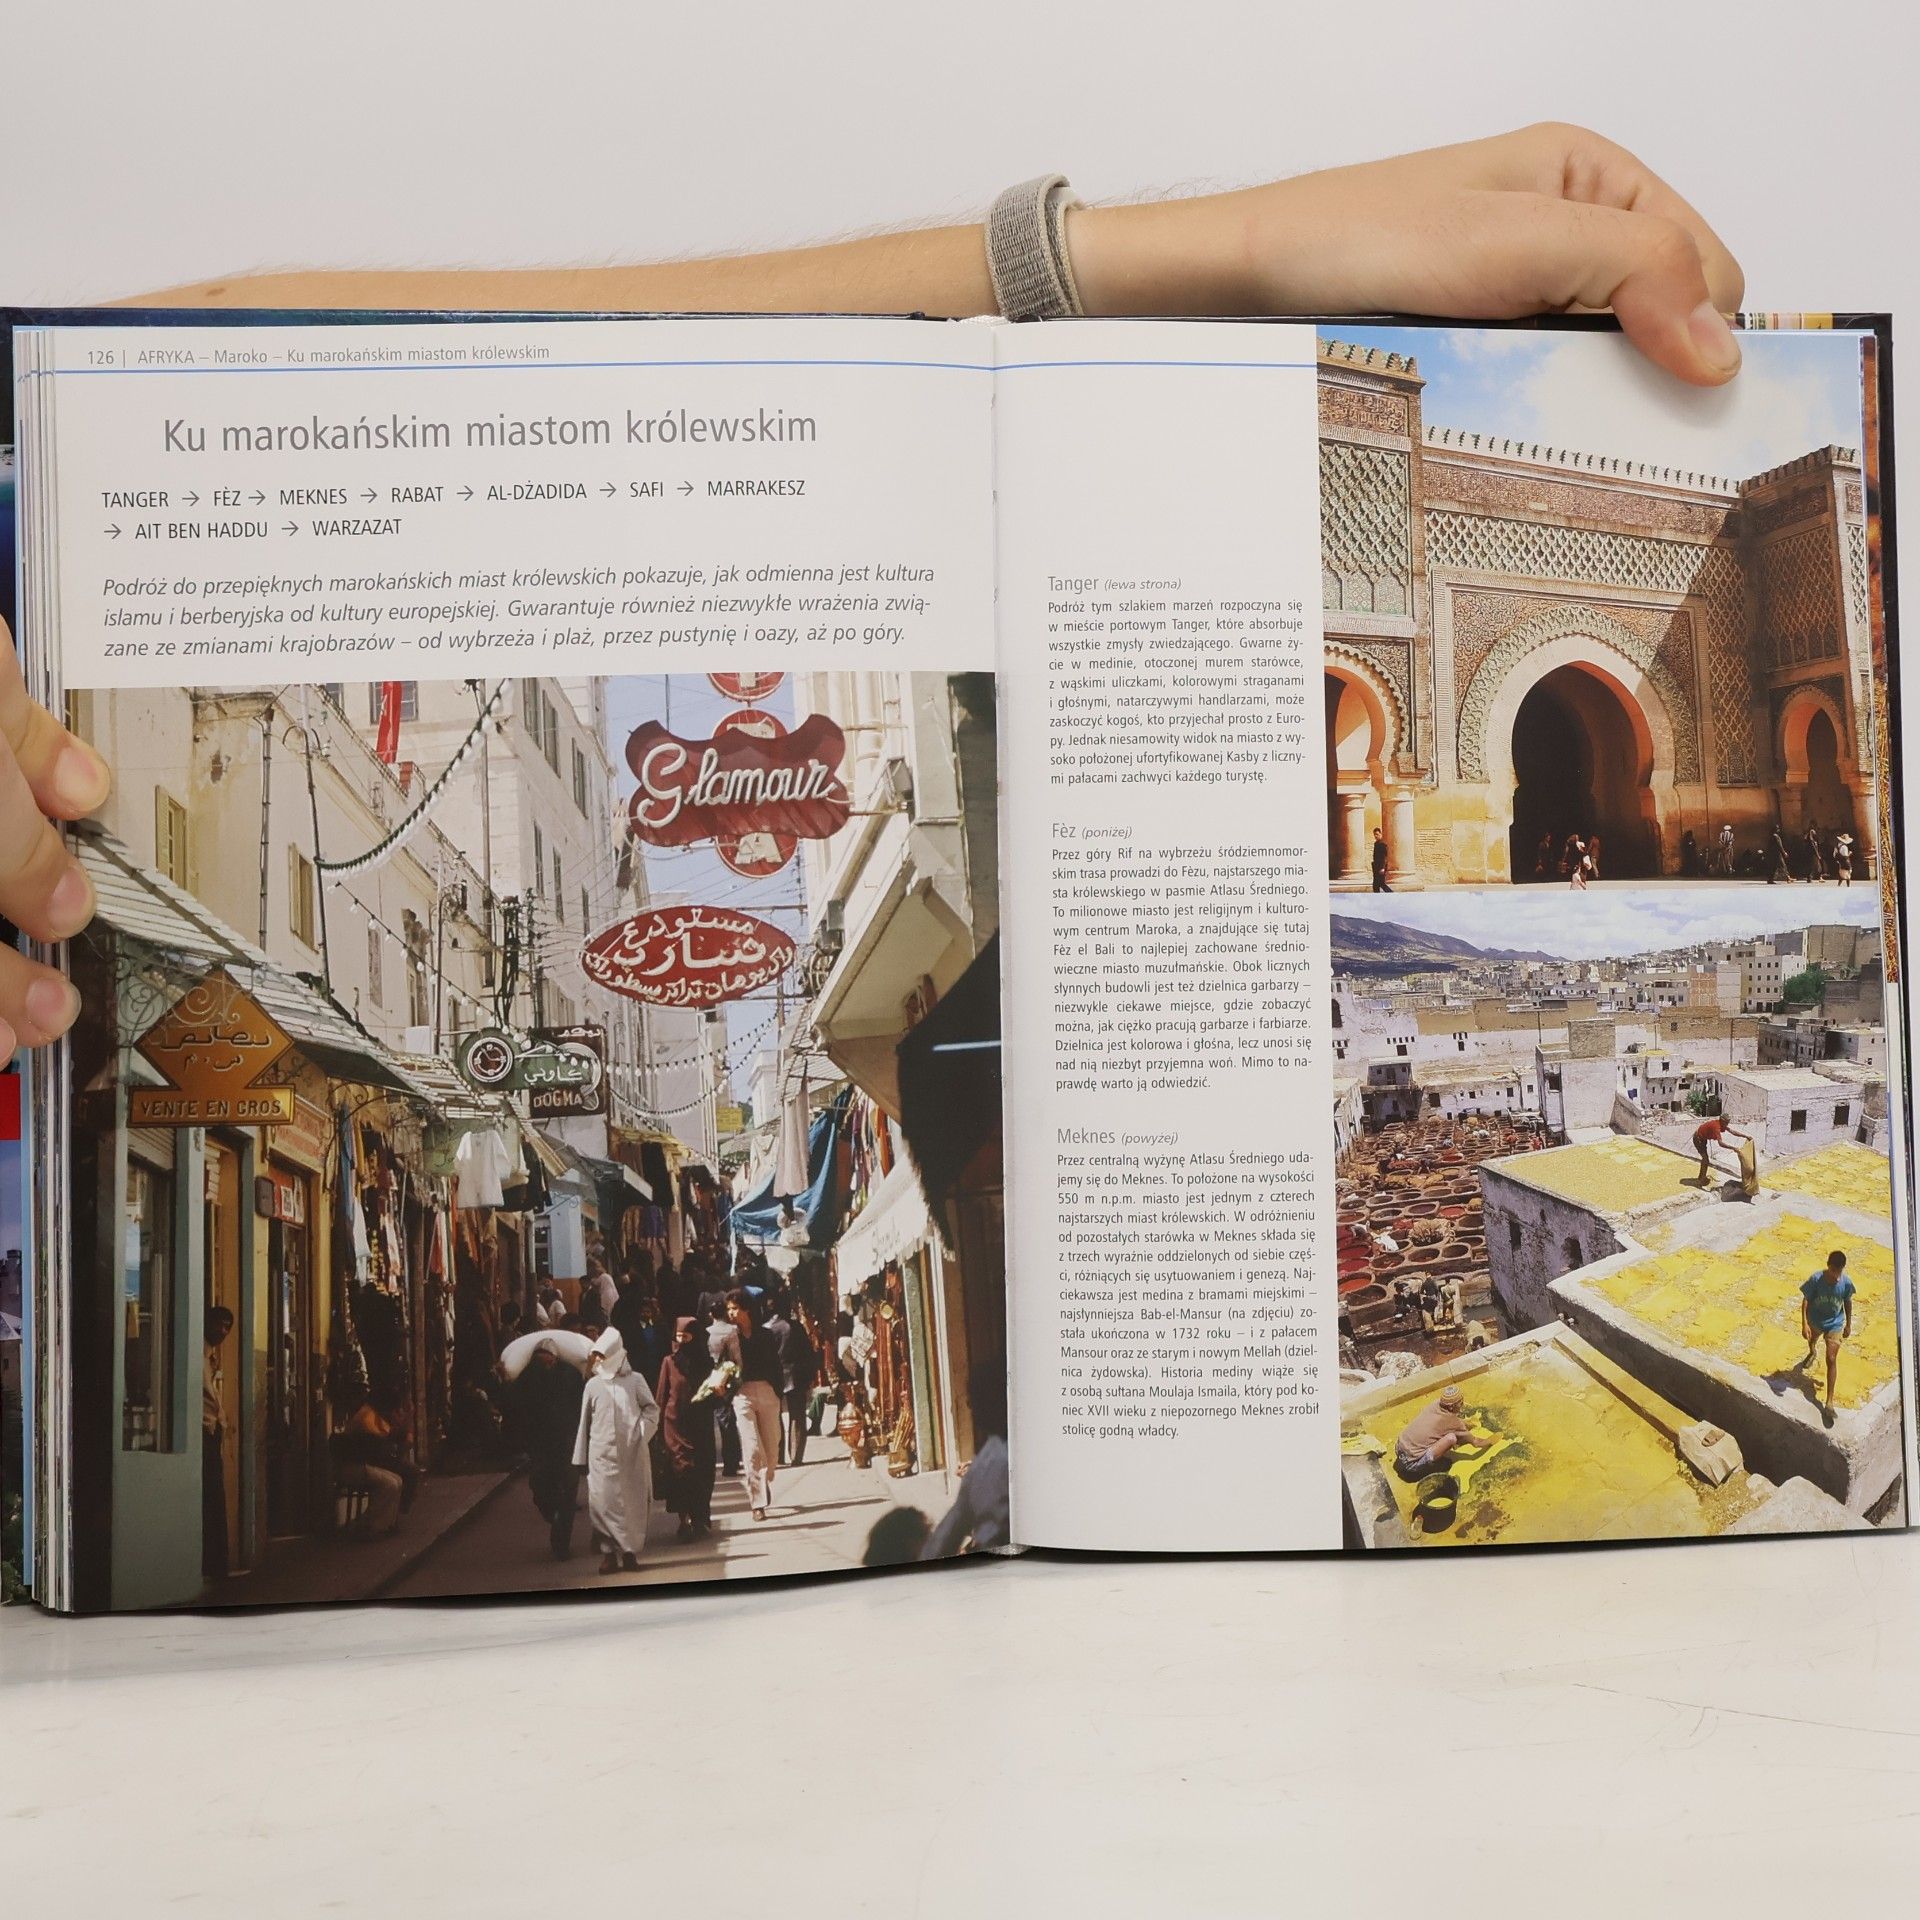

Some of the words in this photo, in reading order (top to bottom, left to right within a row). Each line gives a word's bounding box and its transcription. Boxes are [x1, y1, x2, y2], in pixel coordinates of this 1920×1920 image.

[88, 351, 114, 364] 126
[138, 350, 194, 364] AFRYKA
[215, 348, 267, 363] Maroko
[288, 349, 304, 362] Ku
[311, 347, 402, 362] marokańskim
[408, 348, 466, 360] miastom
[473, 345, 549, 359] królewskim
[165, 420, 205, 452] Ku
[223, 414, 449, 451] marokańskim
[467, 414, 609, 446] miastom
[627, 408, 815, 443] królewskim
[101, 492, 169, 508] TANGER
[214, 486, 241, 506] FÈZ
[280, 489, 347, 505] MEKNES
[392, 486, 444, 503] RABAT
[487, 480, 587, 500] AL-DŻADIDA
[630, 482, 663, 497] SAFI
[708, 480, 805, 496] MARRAKESZ
[135, 523, 162, 539] AIT
[169, 523, 200, 538] BEN
[208, 522, 267, 538] HADDU
[312, 519, 402, 536] WARZAZAT
[103, 578, 167, 596] Podróż
[174, 577, 196, 594] do
[203, 574, 322, 598] przepięknych
[329, 571, 451, 591] marokańskich
[459, 570, 506, 588] miast
[512, 567, 616, 586] królewskich
[622, 566, 706, 588] pokazuje,
[712, 565, 740, 586] jak
[746, 564, 833, 582] odmienna
[837, 564, 870, 585] jest
[876, 564, 934, 581] kultura
[1048, 576, 1099, 595] Tanger
[1105, 579, 1135, 591] (lewa
[1140, 578, 1181, 590] strona)
[104, 608, 162, 626] islamu
[169, 608, 175, 625] i
[180, 605, 283, 628] berberyjska
[291, 604, 314, 622] od
[320, 603, 383, 625] kultury
[389, 600, 498, 623] europejskiej.
[508, 597, 614, 619] Gwarantuje
[622, 595, 695, 614] również
[702, 594, 791, 616] niezwykłe
[799, 594, 878, 611] wrażenia
[885, 594, 930, 615] zwią-
[1049, 601, 1085, 613] Podróż
[1091, 602, 1111, 615] tym
[1119, 600, 1166, 611] szlakiem
[1173, 602, 1213, 611] marzeń
[1221, 602, 1280, 613] rozpoczyna
[1288, 599, 1302, 613] się
[1049, 624, 1058, 632] w
[1064, 620, 1104, 631] mieście
[1110, 620, 1166, 633] portowym
[1172, 619, 1210, 632] Tanger,
[1217, 618, 1244, 629] które
[1249, 618, 1302, 632] absorbuje
[104, 643, 148, 656] zane
[155, 643, 176, 655] ze
[183, 636, 273, 655] zmianami
[280, 633, 395, 656] krajobrazów
[419, 631, 442, 649] od
[449, 629, 534, 652] wybrzeża
[542, 628, 547, 645] i
[553, 627, 594, 650] plaż,
[603, 631, 653, 648] przez
[659, 625, 736, 647] pustynię
[744, 624, 748, 641] i
[755, 629, 798, 645] oazy,
[807, 623, 827, 640] aż
[833, 628, 856, 644] po
[863, 623, 904, 645] góry.
[1049, 638, 1101, 654] wszystkie
[1107, 638, 1143, 652] zmysły
[1150, 637, 1233, 651] zwiedzającego.
[1240, 637, 1282, 648] Gwarne
[1288, 640, 1303, 651] ży-
[1049, 681, 1054, 689] z
[1061, 676, 1105, 691] wąskimi
[1112, 675, 1165, 688] uliczkami,
[1173, 675, 1237, 689] kolorowymi
[1243, 676, 1303, 689] straganami
[636, 742, 838, 829] Glamour
[1051, 773, 1063, 784] mi
[1069, 772, 1117, 787] pałacami
[1122, 771, 1171, 785] zachwyci
[1176, 770, 1222, 784] każdego
[1226, 770, 1267, 784] turystę.
[1053, 823, 1076, 838] Fèz
[1082, 827, 1132, 840] (poniżej)
[1053, 849, 1080, 860] Przez
[1086, 848, 1111, 862] góry
[1118, 847, 1132, 859] Rif
[1139, 850, 1152, 858] na
[1159, 846, 1211, 861] wybrzeżu
[1218, 845, 1307, 857] śródziemnomor-
[1053, 906, 1064, 917] To
[1070, 905, 1127, 917] milionowe
[1133, 905, 1169, 916] miasto
[1174, 904, 1194, 918] jest
[1199, 903, 1253, 918] religijnym
[1266, 902, 1309, 914] kulturo-
[1055, 1001, 1108, 1015] niezwykle
[1117, 1000, 1161, 1012] ciekawe
[1171, 1000, 1214, 1014] miejsce,
[1224, 998, 1253, 1013] gdzie
[1262, 998, 1311, 1012] zobaczyć
[1056, 1077, 1097, 1092] prawdę
[1101, 1079, 1133, 1089] warto
[1137, 1080, 1147, 1092] ją
[1151, 1076, 1210, 1088] odwiedzić.
[533, 1089, 583, 1108] DOGMA
[141, 1100, 198, 1118] VENTE
[206, 1100, 230, 1117] EN
[236, 1099, 283, 1117] GROS
[1058, 1128, 1115, 1143] Meknes
[1122, 1132, 1178, 1146] (powyżej)
[1058, 1155, 1084, 1165] Przez
[1089, 1154, 1139, 1168] centralną
[1144, 1154, 1185, 1168] wyżynę
[1190, 1153, 1224, 1165] Atlasu
[1230, 1151, 1284, 1166] Średniego
[1289, 1151, 1313, 1163] uda-
[1058, 1193, 1078, 1204] 550
[1085, 1196, 1094, 1204] m
[1102, 1196, 1135, 1207] n.p.m.
[1143, 1192, 1179, 1204] miasto
[1186, 1192, 1205, 1207] jest
[1211, 1191, 1251, 1206] jednym
[1258, 1194, 1264, 1202] z
[1270, 1189, 1314, 1202] czterech
[1059, 1212, 1123, 1226] najstarszych
[1128, 1212, 1157, 1223] miast
[1162, 1210, 1229, 1223] królewskich.
[1234, 1211, 1245, 1222] W
[1250, 1210, 1314, 1221] odróżnieniu
[1063, 1423, 1095, 1438] stolicę
[1100, 1424, 1134, 1439] godną
[1138, 1424, 1178, 1439] władcy.
